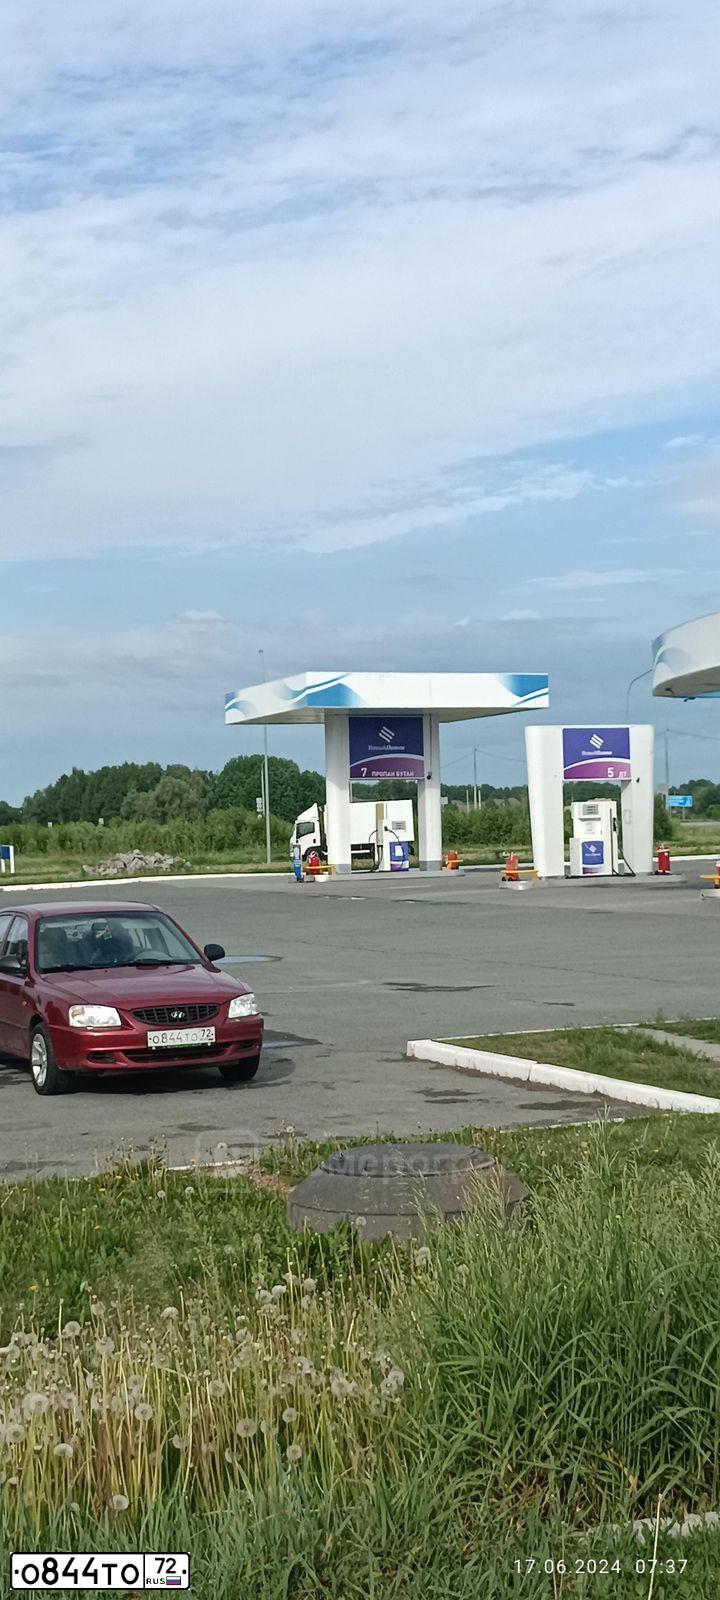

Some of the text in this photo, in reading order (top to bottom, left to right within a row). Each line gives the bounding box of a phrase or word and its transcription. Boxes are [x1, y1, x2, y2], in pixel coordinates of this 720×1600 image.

[361, 767, 368, 778] 7
[607, 767, 614, 778] 5
[152, 1028, 212, 1044] О844ТО 72
